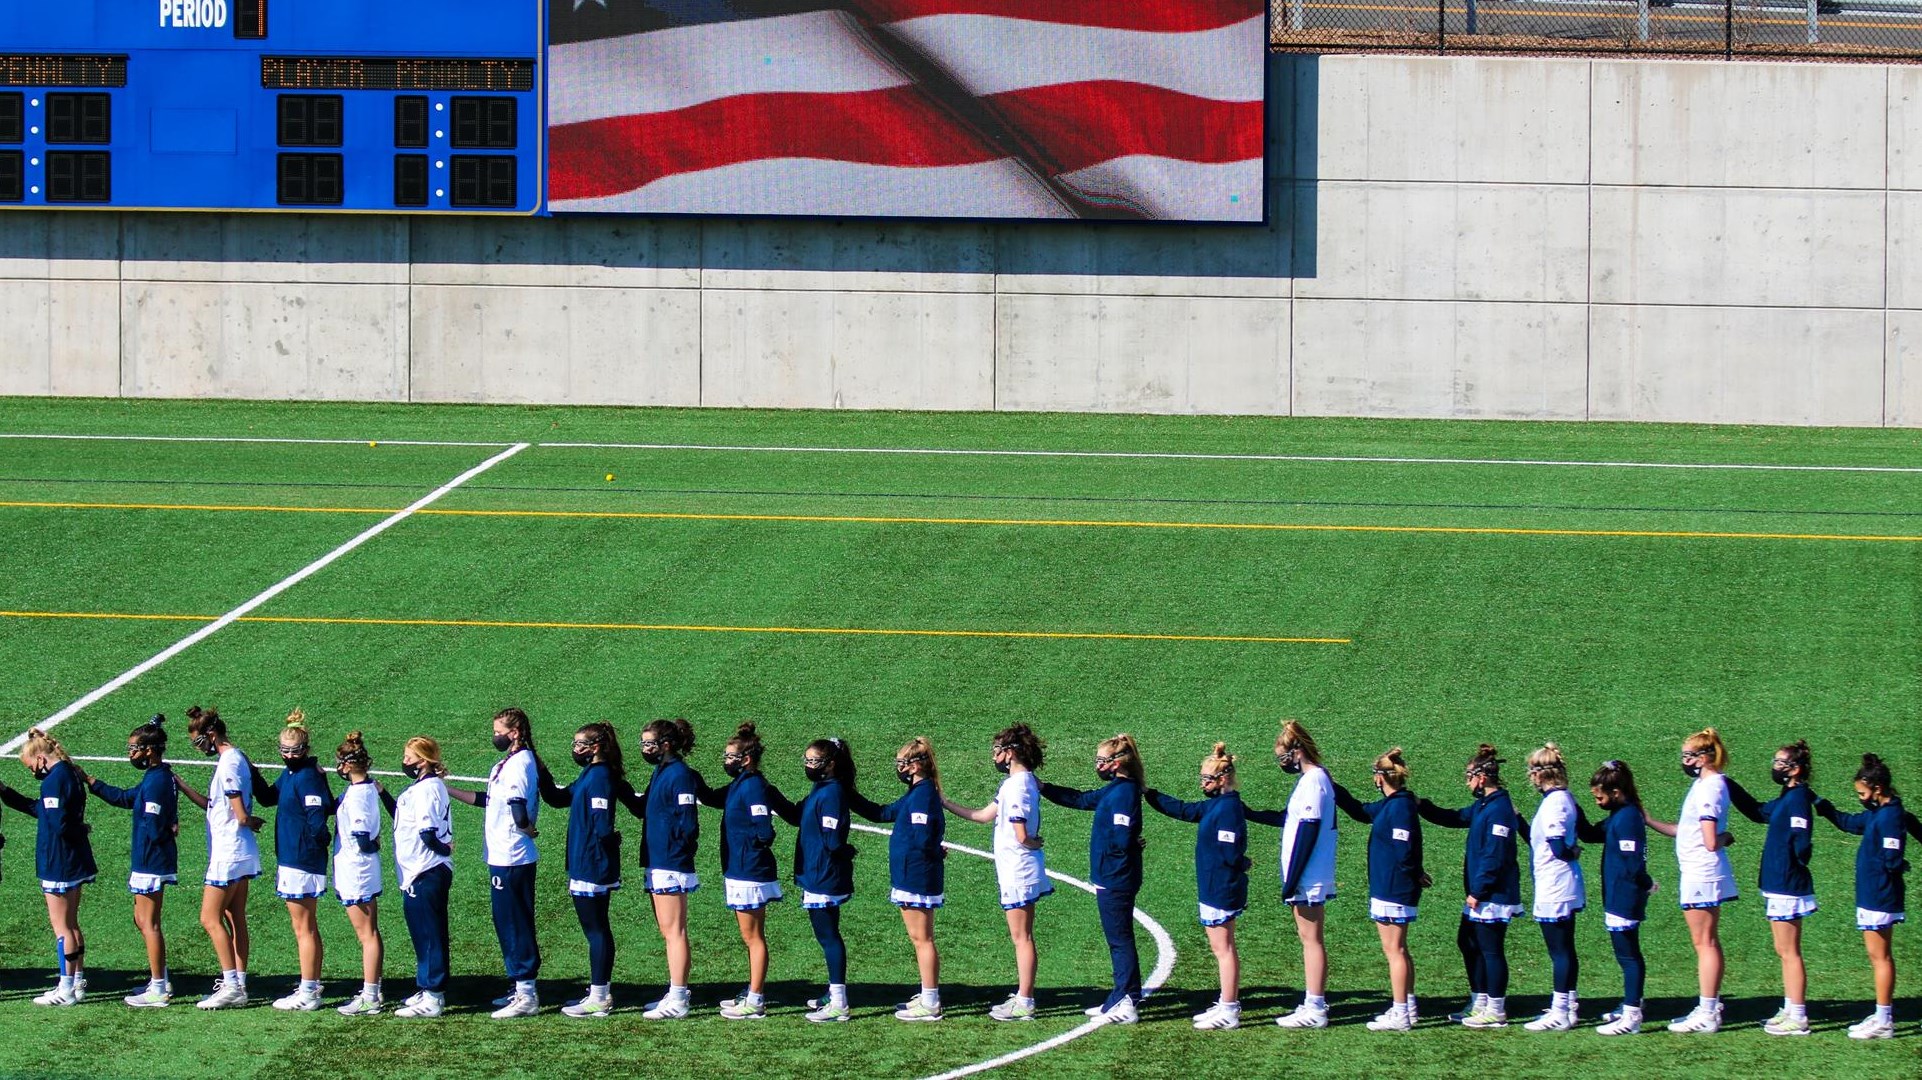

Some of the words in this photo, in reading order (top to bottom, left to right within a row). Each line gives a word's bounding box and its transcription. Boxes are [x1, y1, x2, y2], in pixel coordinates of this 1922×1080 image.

[160, 0, 227, 28] PERIOD
[263, 59, 363, 87] PLAYER
[397, 60, 518, 89] PENALTY
[491, 875, 504, 890] Q
